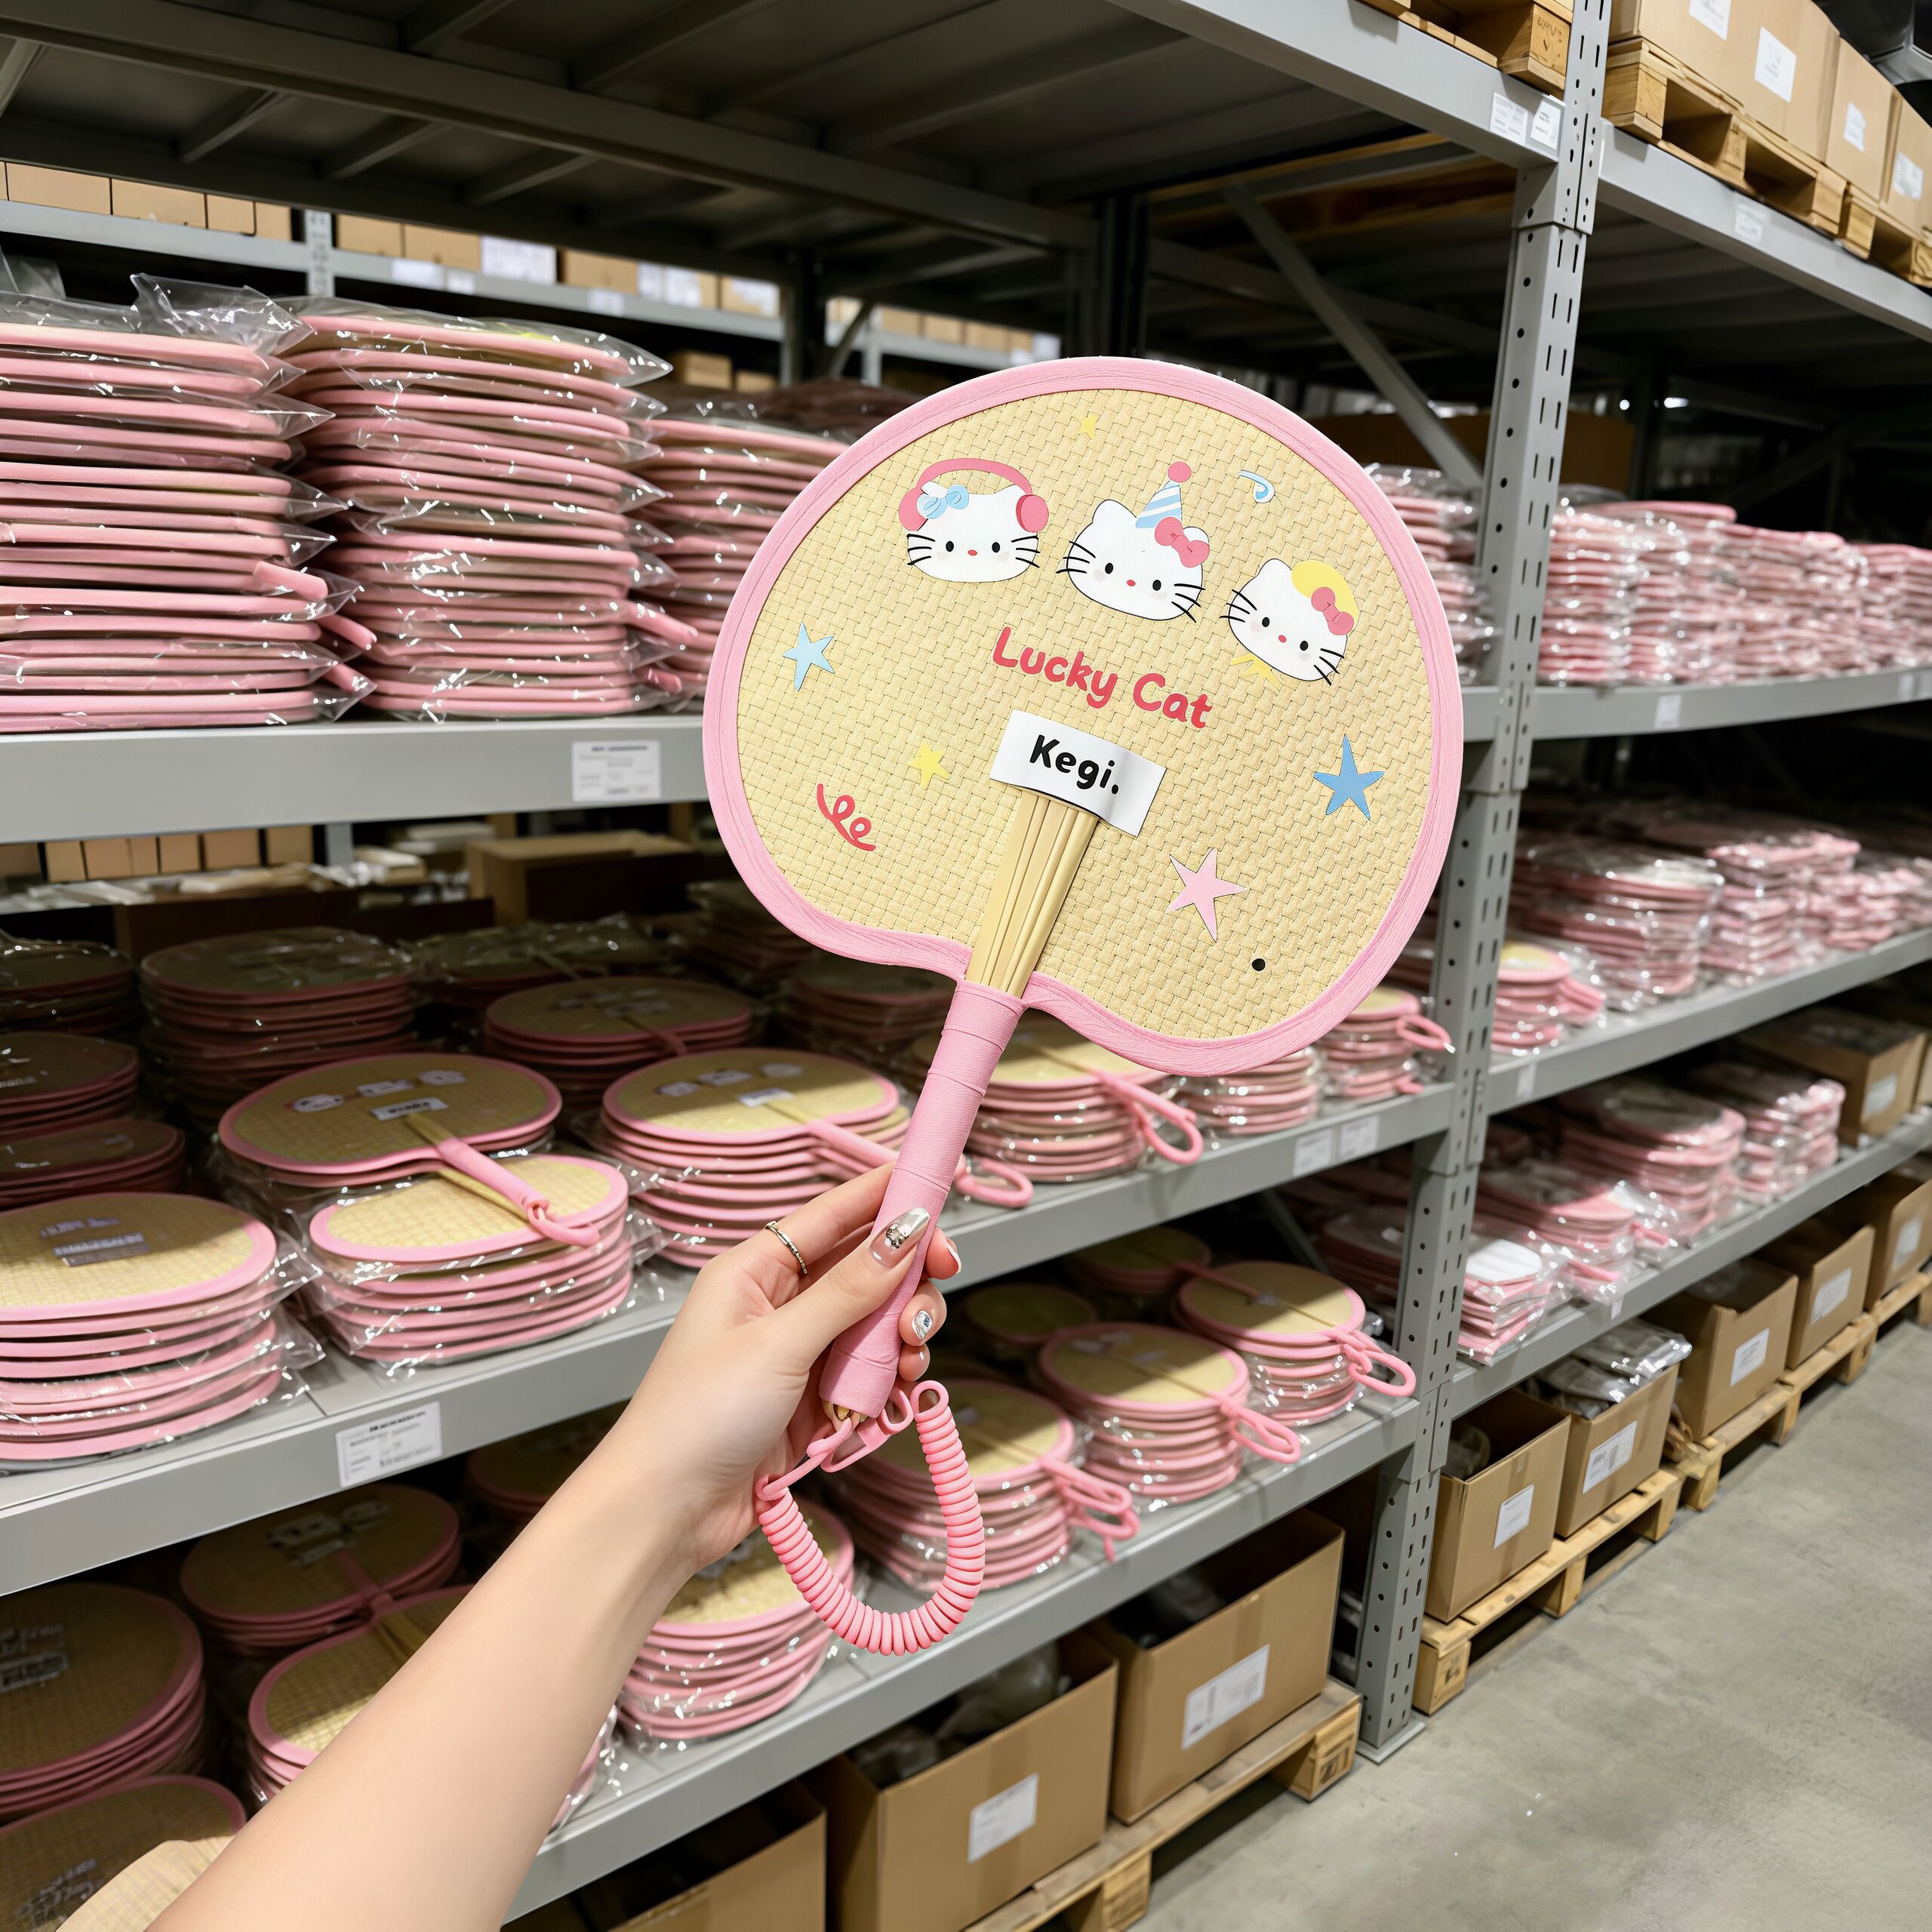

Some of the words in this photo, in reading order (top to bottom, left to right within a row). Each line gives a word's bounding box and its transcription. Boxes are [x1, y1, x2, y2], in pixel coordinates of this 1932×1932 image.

[992, 626, 1118, 709] Lucky
[1133, 673, 1212, 728] Cat
[1029, 734, 1118, 795] Kegi.
